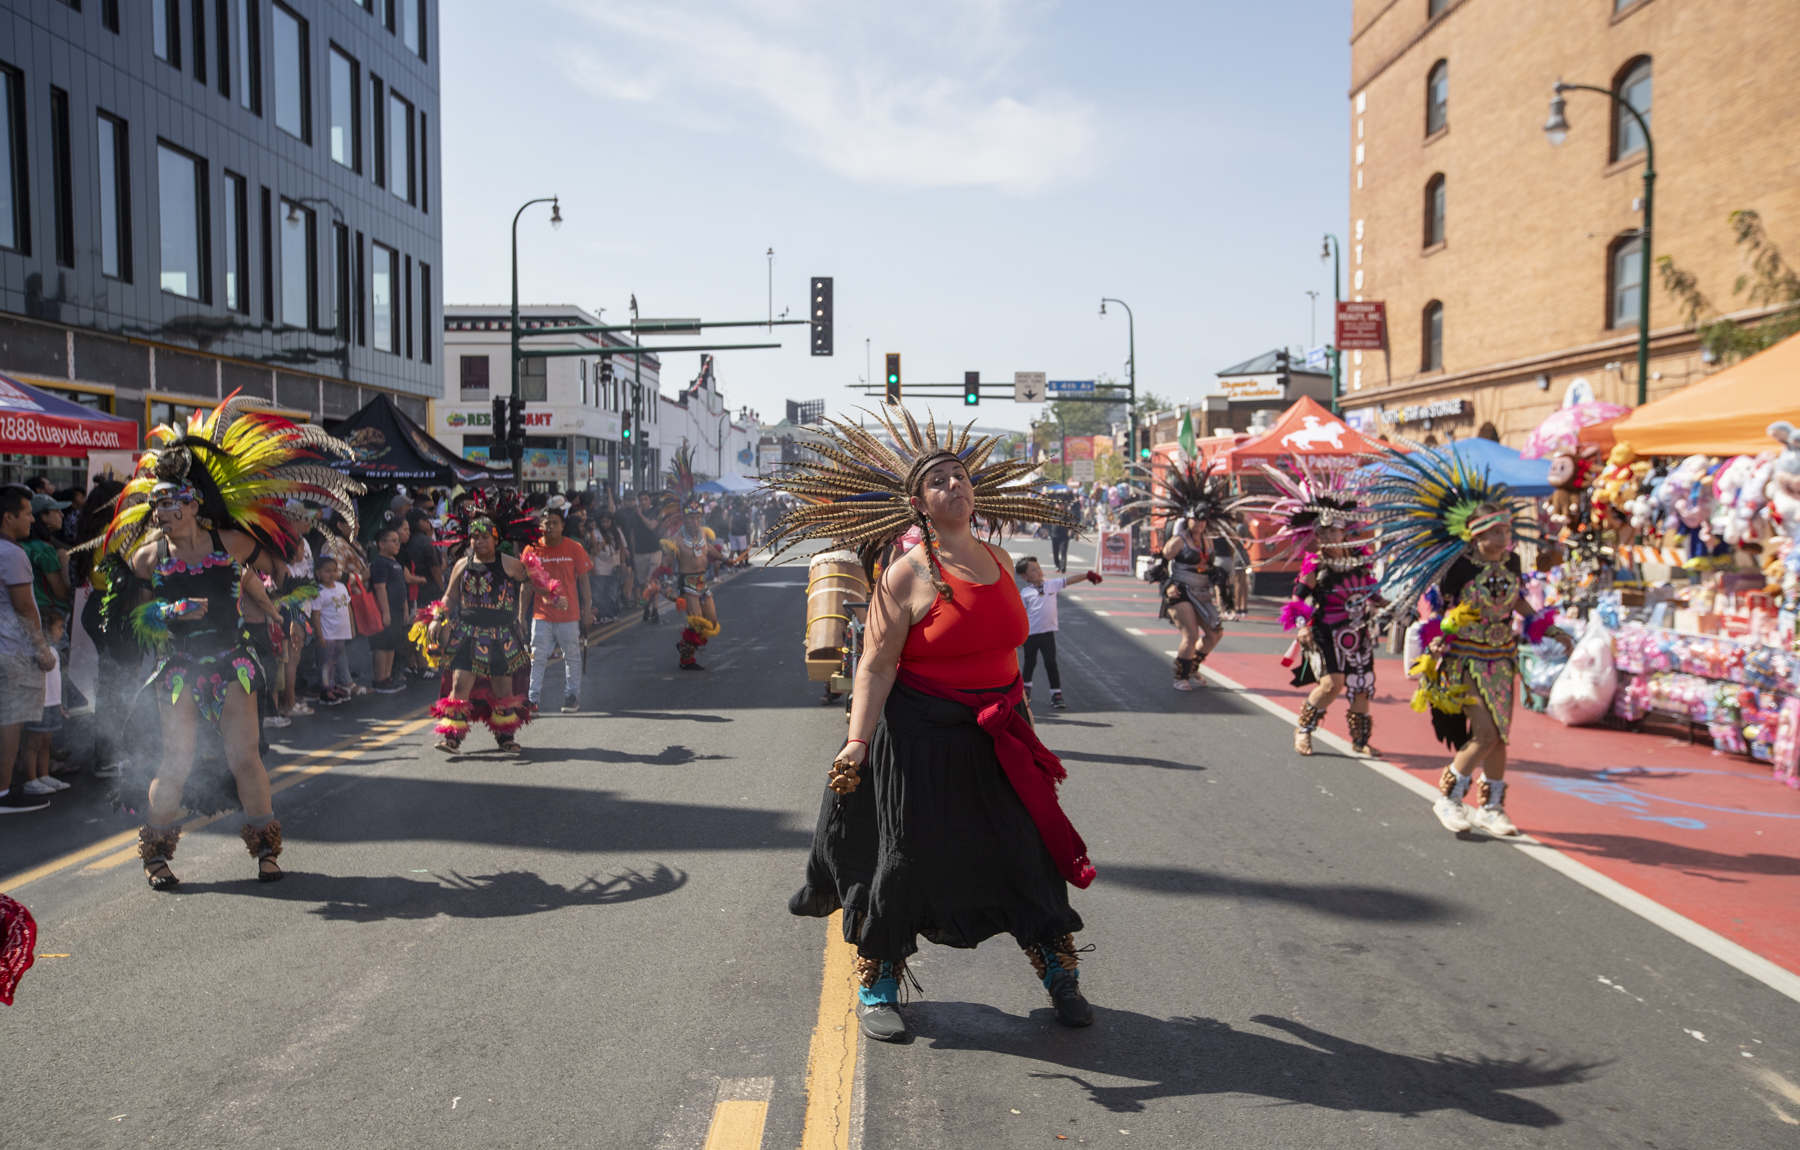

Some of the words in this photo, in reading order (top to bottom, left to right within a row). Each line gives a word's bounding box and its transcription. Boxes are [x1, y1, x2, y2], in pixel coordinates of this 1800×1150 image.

[1353, 218, 1365, 391] STOGE
[1051, 382, 1058, 390] S
[1061, 382, 1077, 390] 4th
[1081, 382, 1092, 390] Av
[1102, 558, 1129, 567] OPEN
